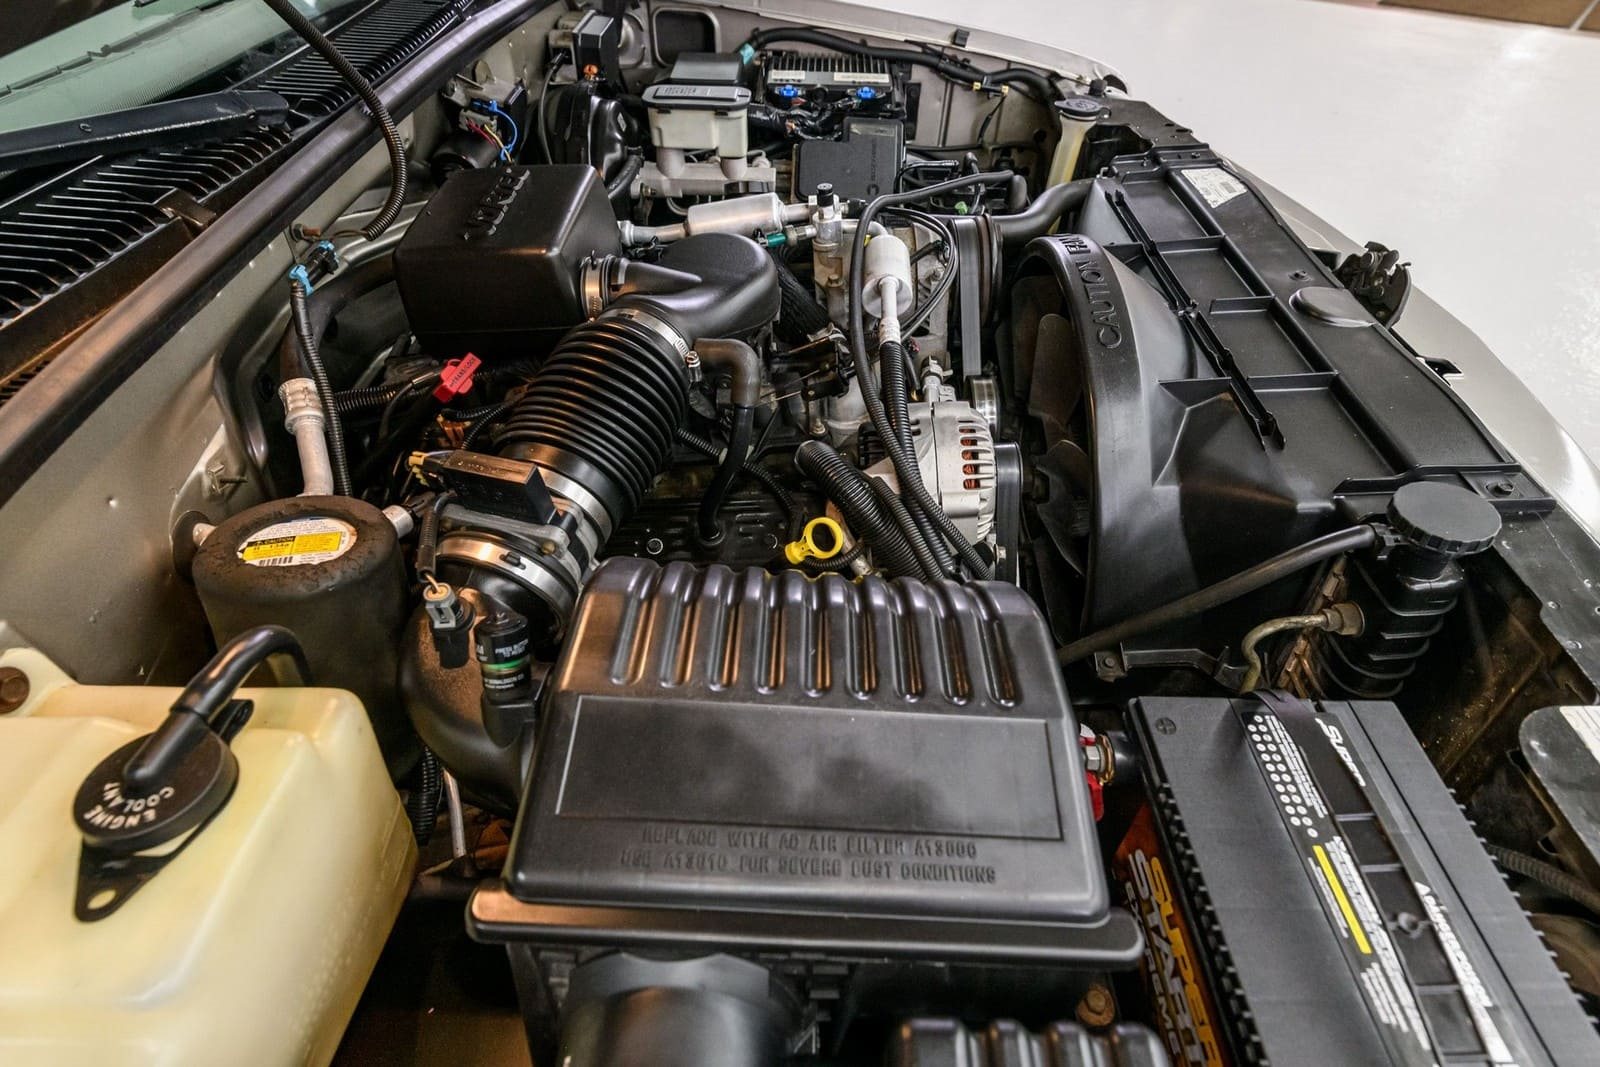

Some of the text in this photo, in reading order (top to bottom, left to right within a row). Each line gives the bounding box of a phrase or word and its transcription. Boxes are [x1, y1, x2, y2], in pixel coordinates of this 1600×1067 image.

[1075, 260, 1122, 349] CAUTION
[83, 804, 156, 830] ENGINE
[641, 823, 718, 848] REPLACE
[727, 830, 769, 850] WITH
[808, 833, 837, 852] AIR
[846, 835, 904, 857] FILTER
[620, 849, 650, 869] USE
[739, 855, 769, 875] FOR
[778, 856, 842, 878] SEVERE
[850, 859, 892, 881] DUST
[900, 861, 997, 885] CONDITIONS
[1128, 849, 1208, 1067] START
[1145, 857, 1223, 1067] SUPER
